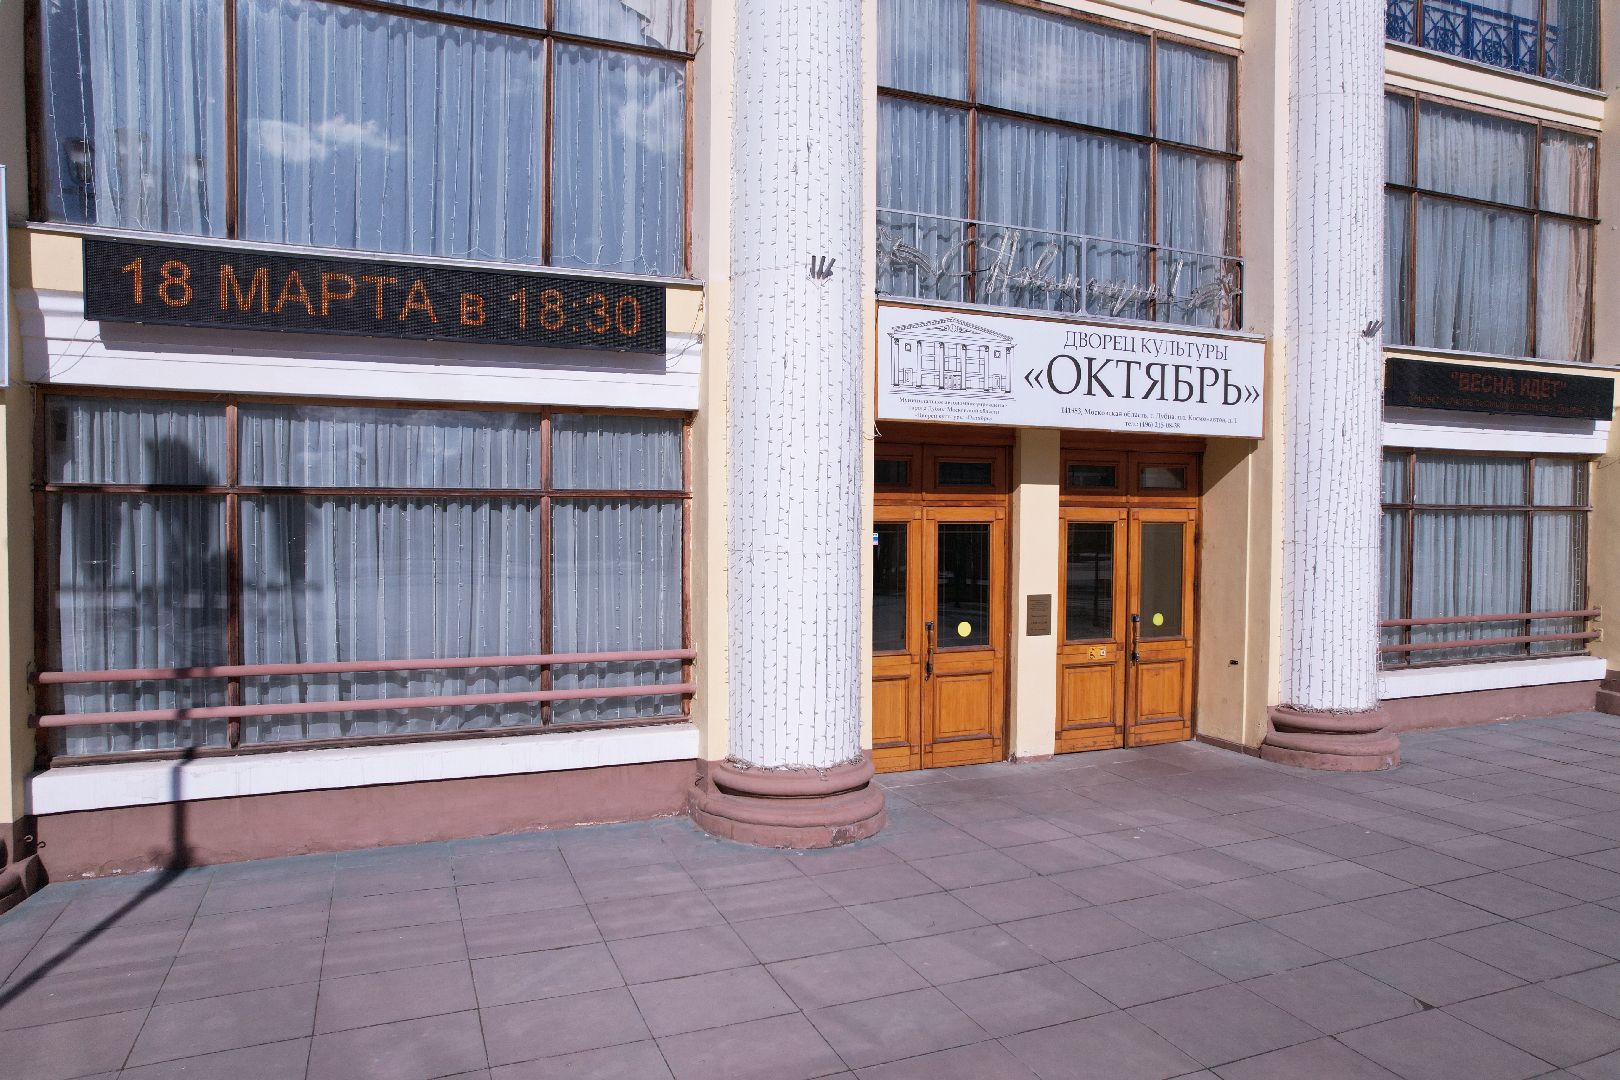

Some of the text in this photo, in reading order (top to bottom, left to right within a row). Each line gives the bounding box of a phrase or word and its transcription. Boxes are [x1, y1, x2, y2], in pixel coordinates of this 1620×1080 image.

[121, 257, 193, 308] 18
[219, 264, 439, 324] МАРТА
[510, 287, 642, 337] 18:30
[1063, 330, 1229, 362] ДВОРЕЦ КУЛЬТУРЫ
[1024, 353, 1260, 406] «ОКТЯБРЬ»
